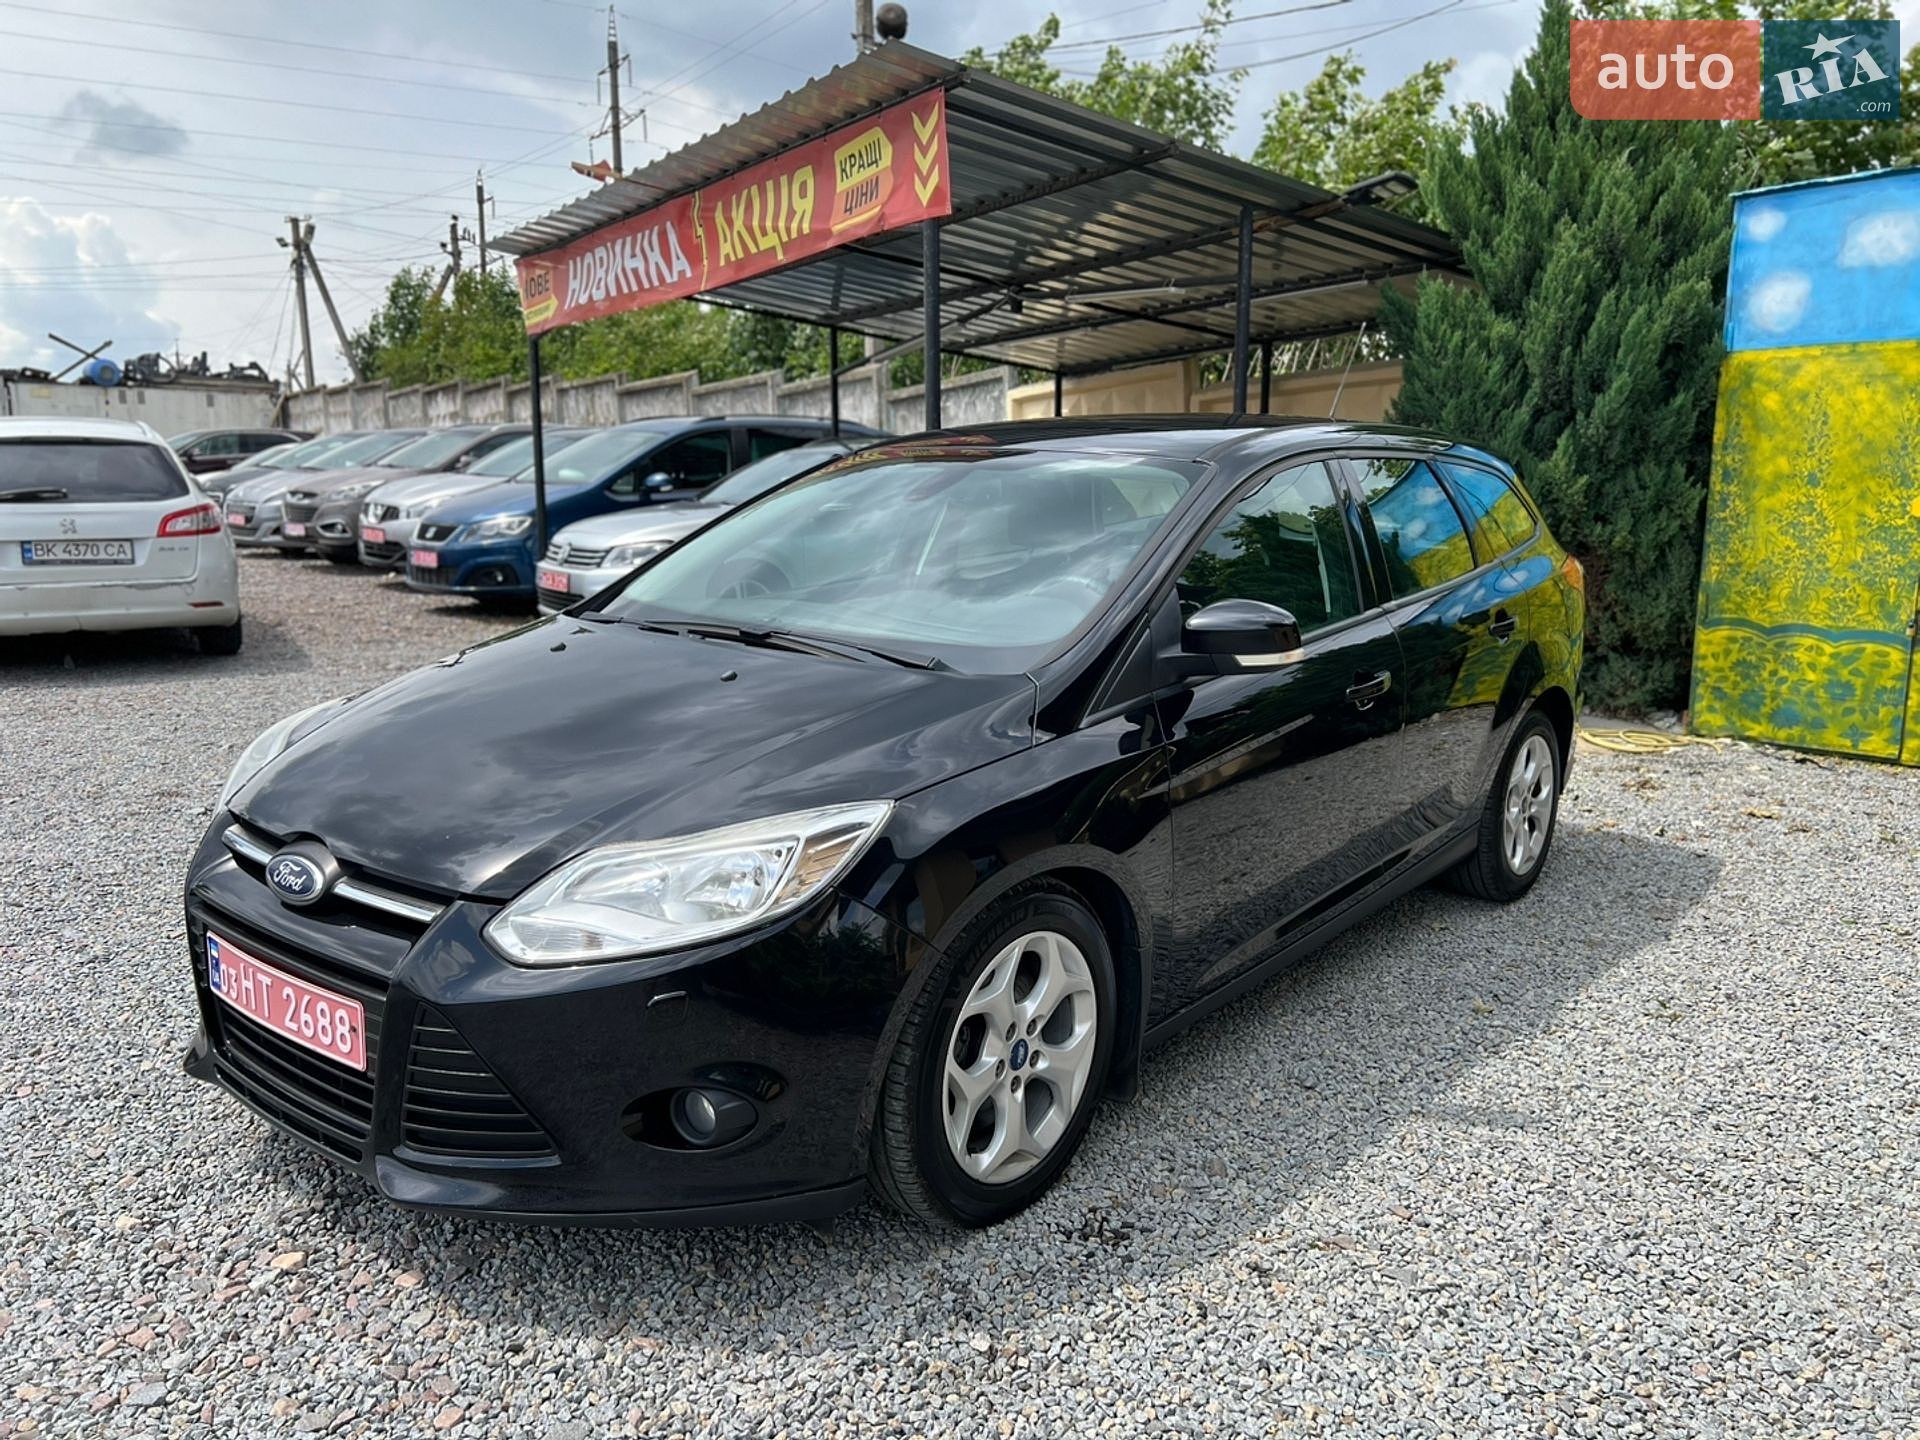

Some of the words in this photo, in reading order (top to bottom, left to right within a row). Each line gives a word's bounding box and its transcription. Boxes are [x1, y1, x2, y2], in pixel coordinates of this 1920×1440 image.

[840, 138, 882, 182] КРАЩІ
[714, 165, 815, 267] АКЦІЯ
[844, 175, 880, 215] ЦІНИ
[563, 221, 693, 310] НОВИНКА
[33, 543, 57, 558] BK
[62, 543, 100, 557] 4370
[103, 543, 128, 557] CA
[273, 861, 307, 892] Ford
[282, 986, 353, 1054] 2688
